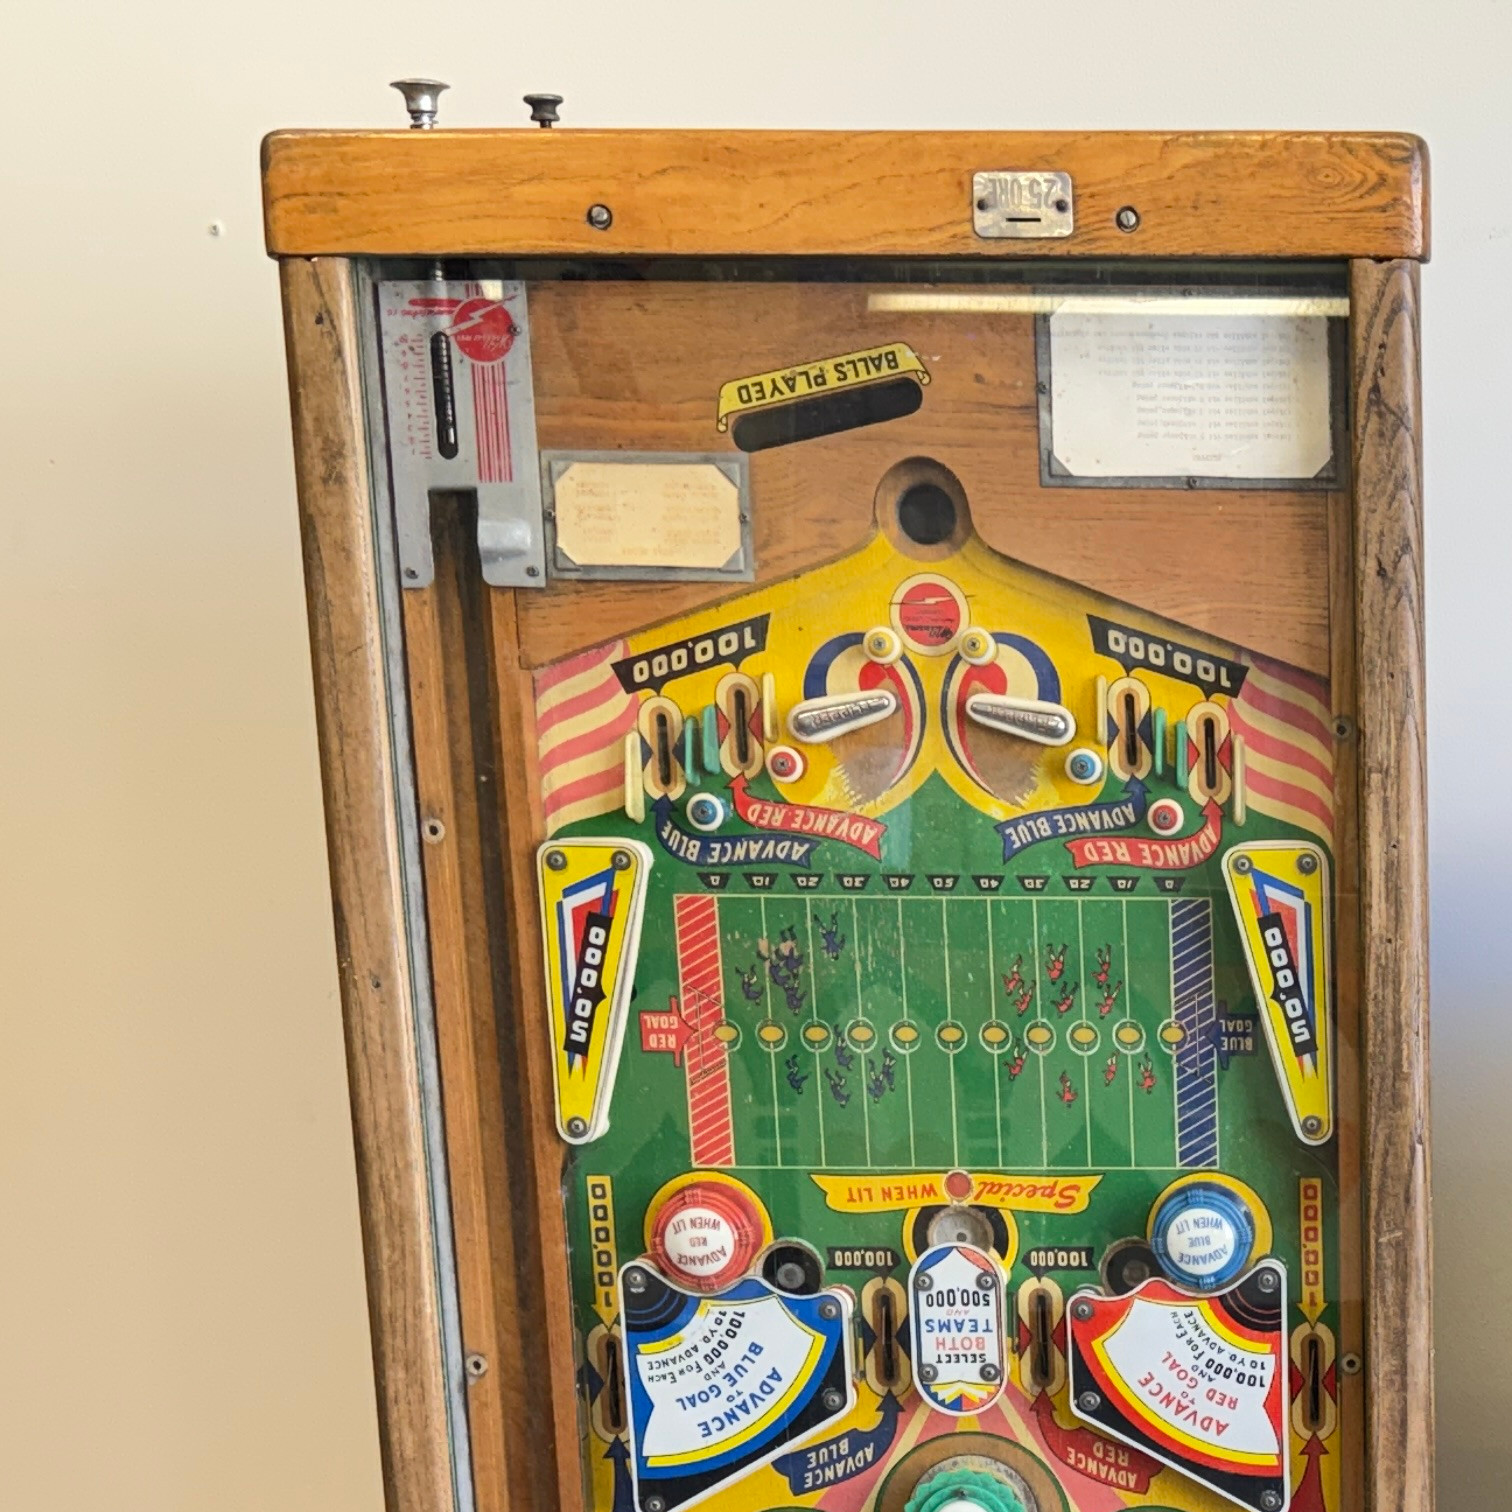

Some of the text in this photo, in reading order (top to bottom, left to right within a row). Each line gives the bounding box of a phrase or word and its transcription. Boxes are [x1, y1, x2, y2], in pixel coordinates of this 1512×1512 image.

[1028, 178, 1057, 209] 25
[736, 350, 899, 405] BALLS PLAYED
[633, 627, 755, 683] 100,000
[1107, 629, 1232, 689] 100,000
[747, 804, 876, 843] ADVANCE RED
[1004, 804, 1135, 848] ADVANCE BLUE
[662, 821, 809, 863] ADVANCE BLUE
[1083, 826, 1217, 864] ADVANCE RED
[644, 1015, 678, 1029] GOAL
[1219, 1019, 1252, 1032] GOAL
[649, 1034, 676, 1049] RED
[1221, 1036, 1253, 1051] BLUE
[847, 1182, 1080, 1208] Special WHEN LIT
[672, 1218, 721, 1234] WHEN LIT
[1175, 1217, 1222, 1234] WHEN LIT
[676, 1246, 727, 1266] ADVANCE
[834, 1249, 893, 1266] 100,000
[1030, 1250, 1087, 1268] 100,000
[1177, 1245, 1228, 1264] ADVANCE
[926, 1287, 990, 1307] 500,000
[924, 1318, 993, 1333] TEAMS
[1184, 1311, 1225, 1357] ADVANCE
[647, 1342, 699, 1370] ADVANCE
[935, 1336, 986, 1351] BOTH
[703, 1361, 725, 1381] AND
[936, 1353, 987, 1364] SELECT
[676, 1341, 764, 1410] BLUE GOAL
[1162, 1350, 1238, 1410] RED GOAL
[1190, 1364, 1215, 1383] AND
[697, 1368, 783, 1437] ADVANCE
[726, 1388, 743, 1403] TO
[1138, 1372, 1229, 1436] ADVANCE
[1180, 1390, 1195, 1404] TO
[807, 1438, 849, 1466] BLUE
[1092, 1441, 1128, 1466] RED
[804, 1443, 874, 1488] ADVANCE
[1066, 1446, 1138, 1488] ADVANCE
